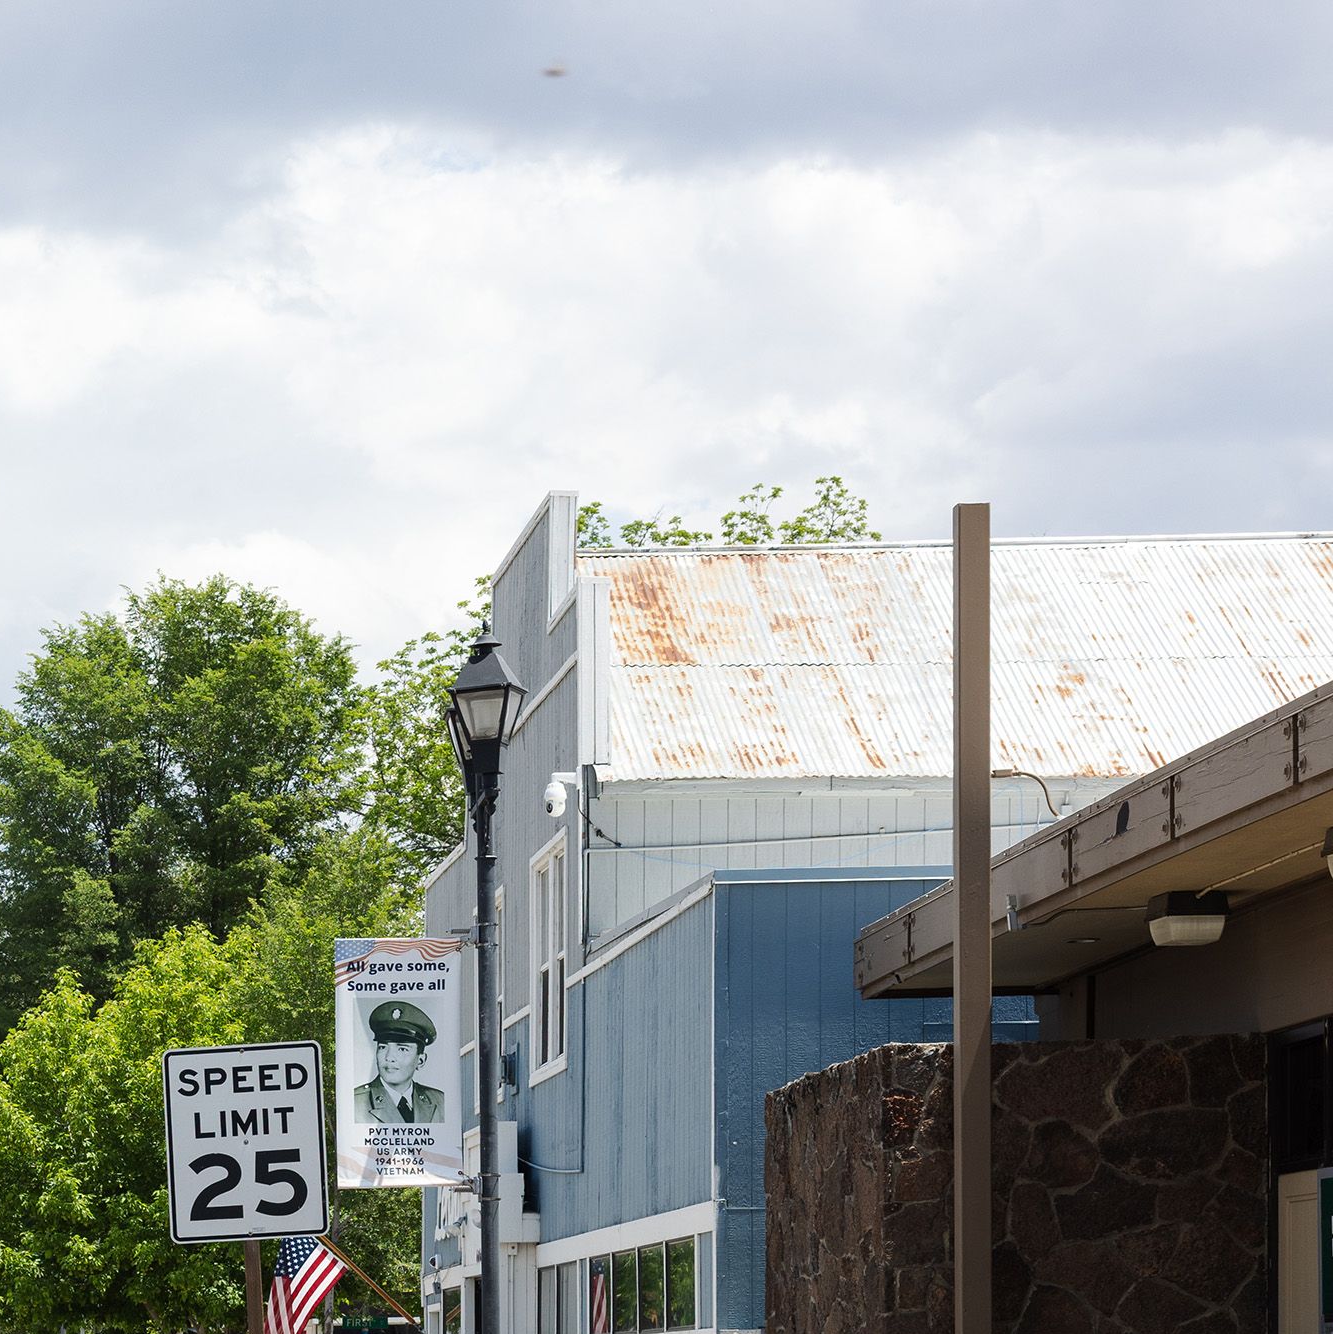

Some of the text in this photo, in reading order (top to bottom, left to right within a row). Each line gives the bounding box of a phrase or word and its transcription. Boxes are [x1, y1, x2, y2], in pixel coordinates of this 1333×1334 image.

[346, 960, 450, 975] All gave some,
[347, 979, 446, 994] Some gave all
[178, 1063, 308, 1097] SPEED
[194, 1107, 294, 1139] LIMIT
[369, 1128, 430, 1136] PVT MYRON
[364, 1138, 435, 1146] MCCLELLAND
[377, 1148, 422, 1156] US ARMY
[375, 1158, 425, 1166] 1941-1966
[188, 1148, 308, 1222] 25
[346, 1318, 373, 1328] FIRST
